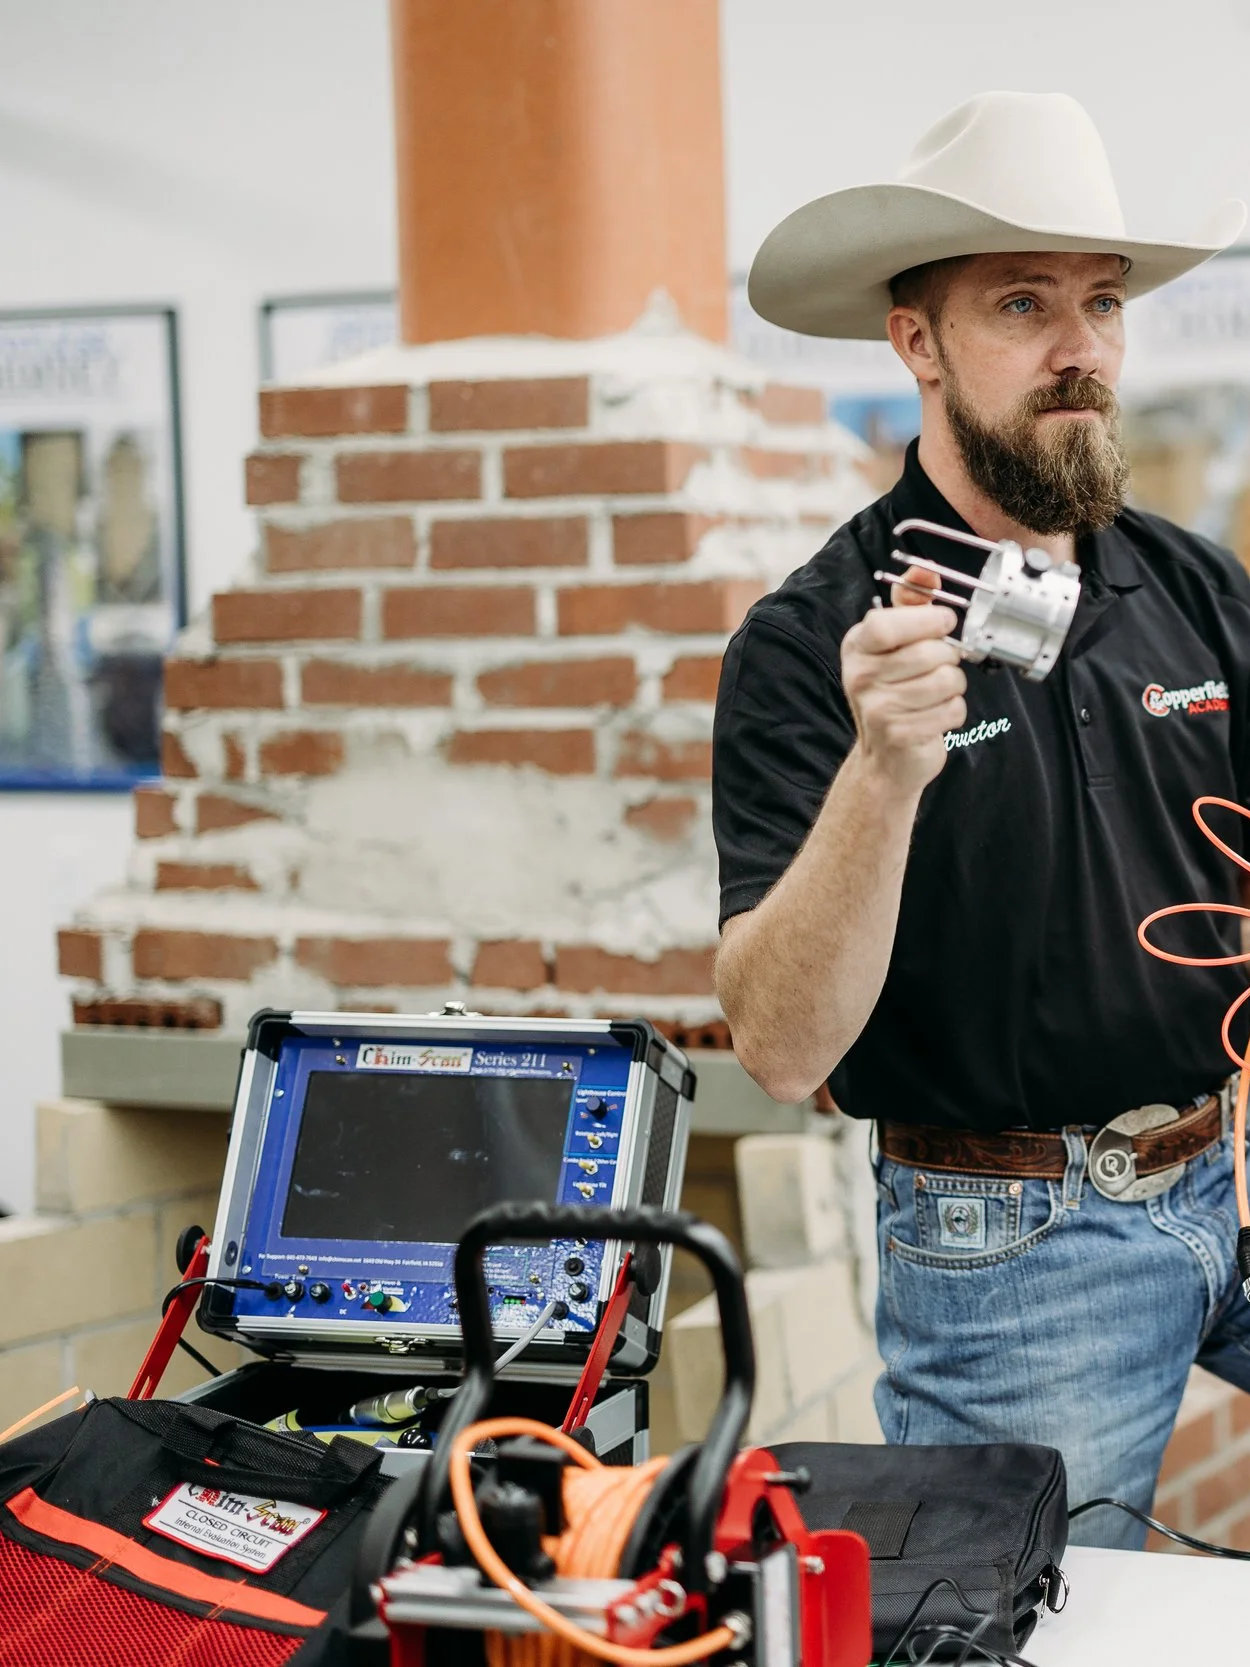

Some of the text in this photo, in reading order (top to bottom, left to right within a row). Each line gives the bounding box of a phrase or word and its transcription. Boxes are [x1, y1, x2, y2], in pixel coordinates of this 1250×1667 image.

[944, 718, 1011, 751] tructor
[475, 1051, 546, 1068] Series 211
[174, 1517, 266, 1559] Internal Evaluation System
[185, 1509, 273, 1549] CLOSED CIRCUIT
